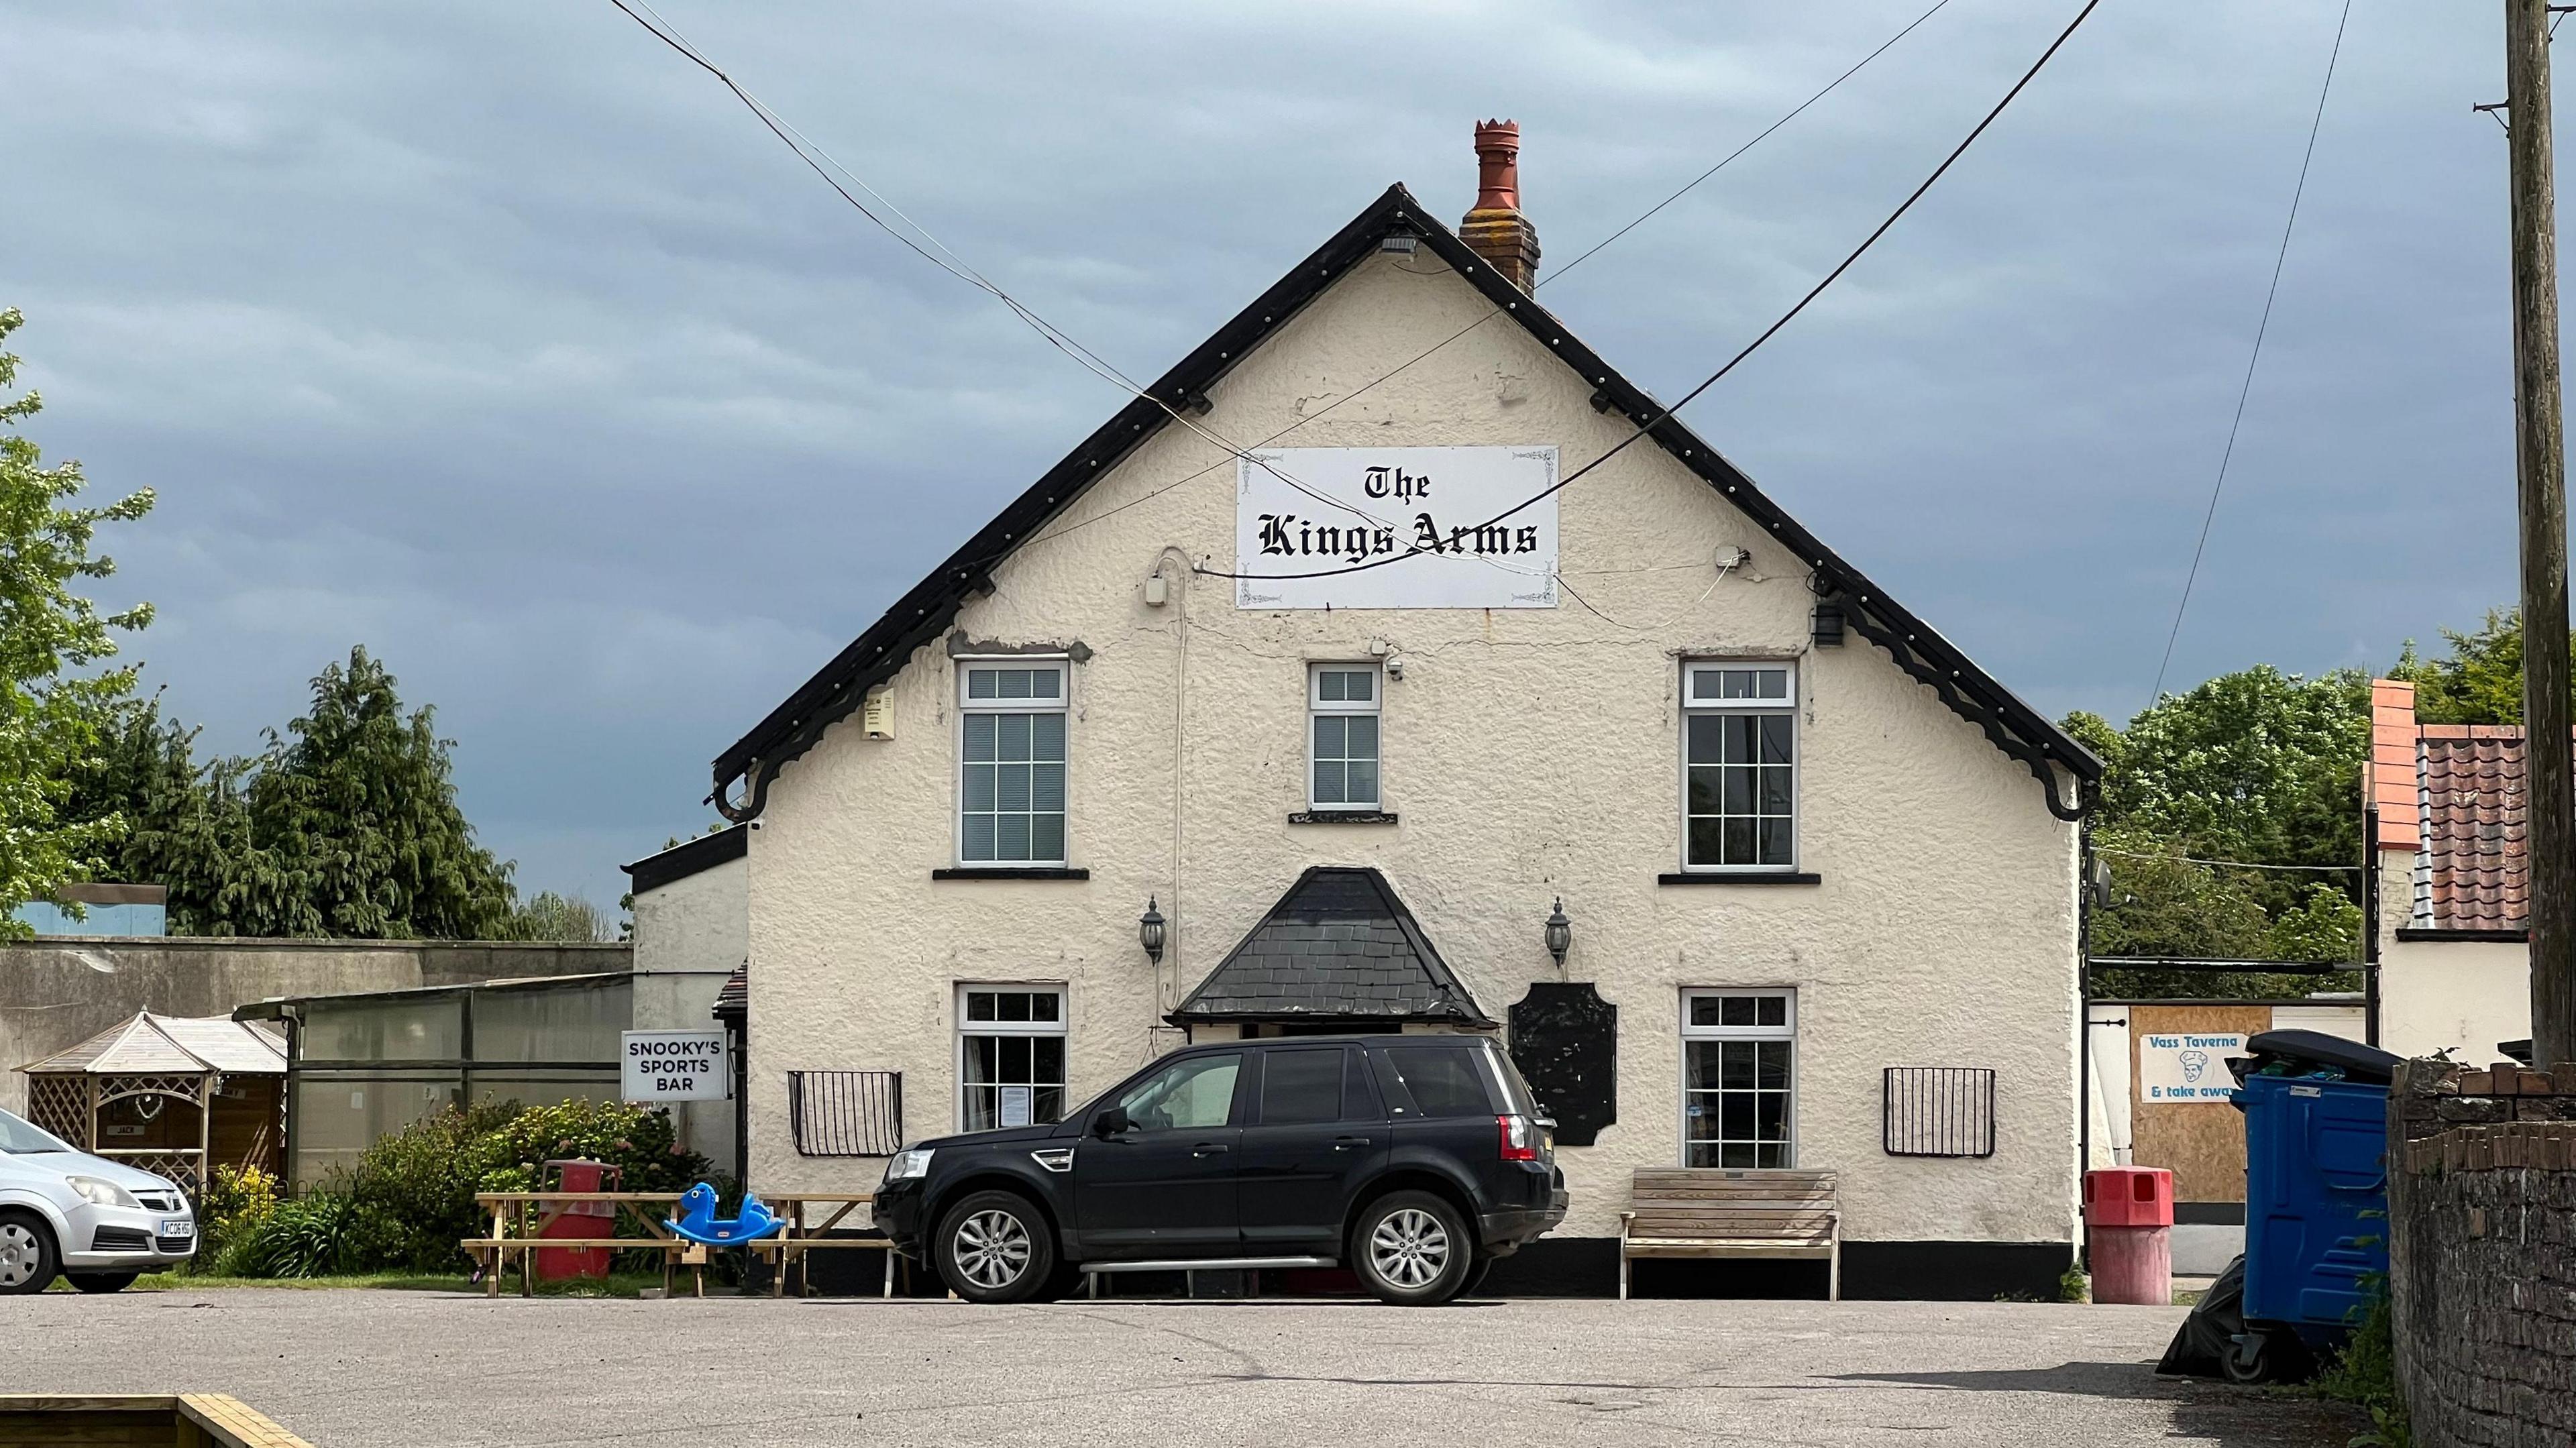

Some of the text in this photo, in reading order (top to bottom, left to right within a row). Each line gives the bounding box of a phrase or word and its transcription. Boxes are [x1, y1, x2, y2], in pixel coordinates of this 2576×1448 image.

[1364, 465, 1430, 505] The
[1258, 512, 1538, 564] Kings Arms
[629, 1040, 720, 1056] SNOOKY'S
[2149, 1036, 2237, 1048] Vass Taverna
[640, 1059, 710, 1074] SPORTS
[656, 1077, 694, 1091] BAR
[2151, 1087, 2161, 1097] &
[2167, 1086, 2196, 1097] take
[165, 1223, 181, 1234] KC06
